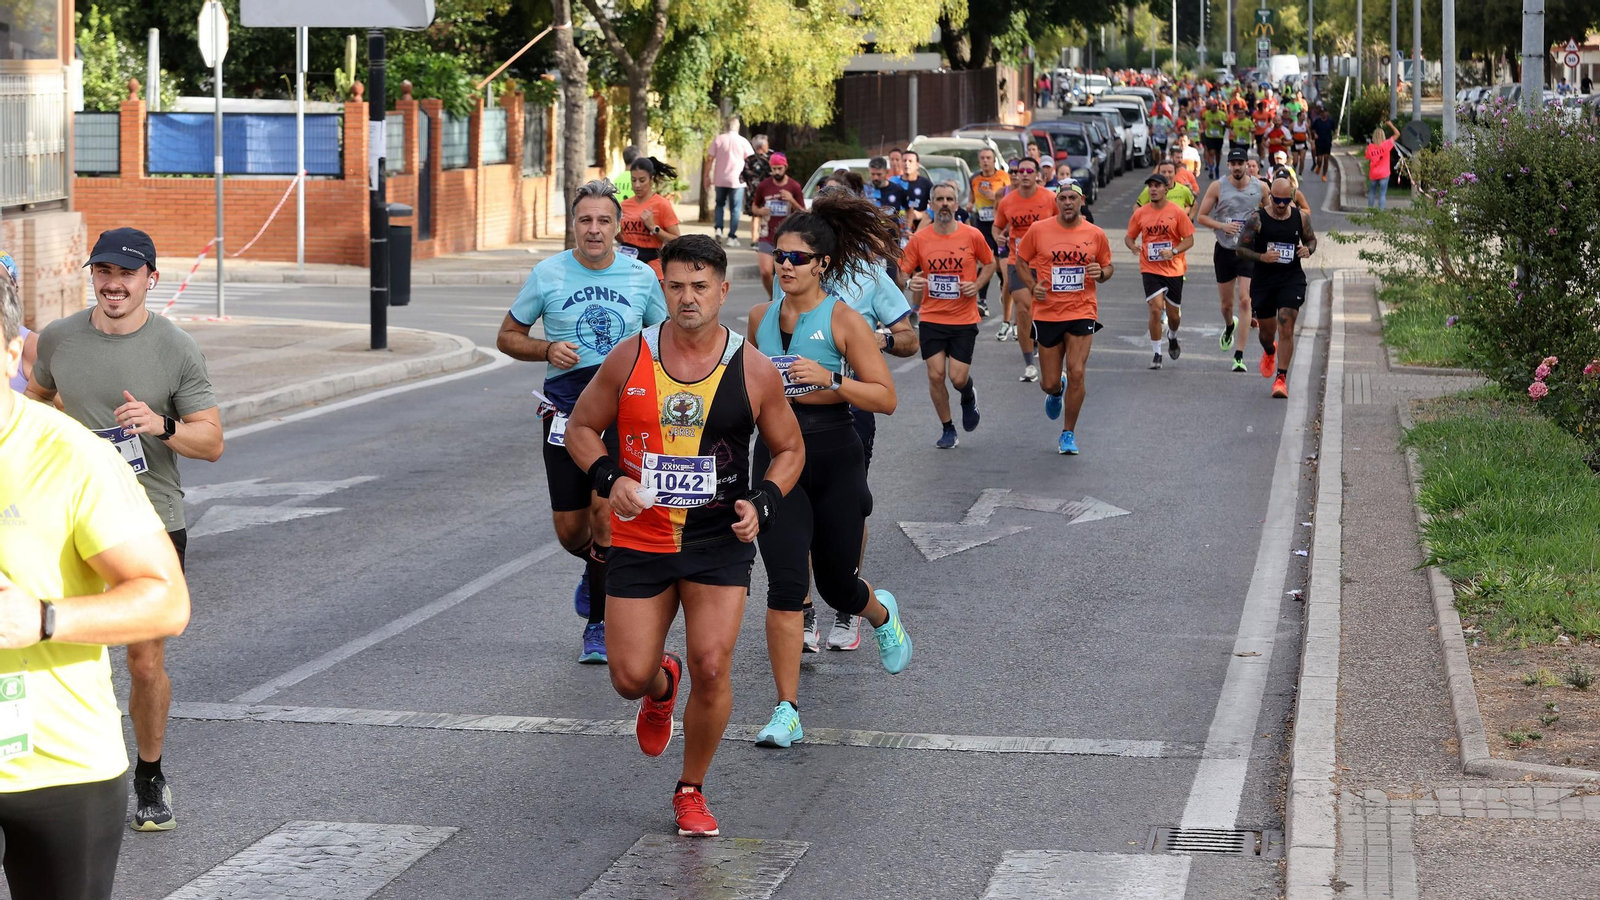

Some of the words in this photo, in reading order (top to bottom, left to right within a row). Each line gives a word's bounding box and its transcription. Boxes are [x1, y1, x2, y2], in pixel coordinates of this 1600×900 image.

[928, 257, 963, 270] XXIX
[1060, 275, 1077, 283] 701
[934, 283, 952, 291] 785
[573, 286, 618, 303] CPNF
[668, 428, 695, 437] JEREZ
[653, 473, 704, 491] 1042
